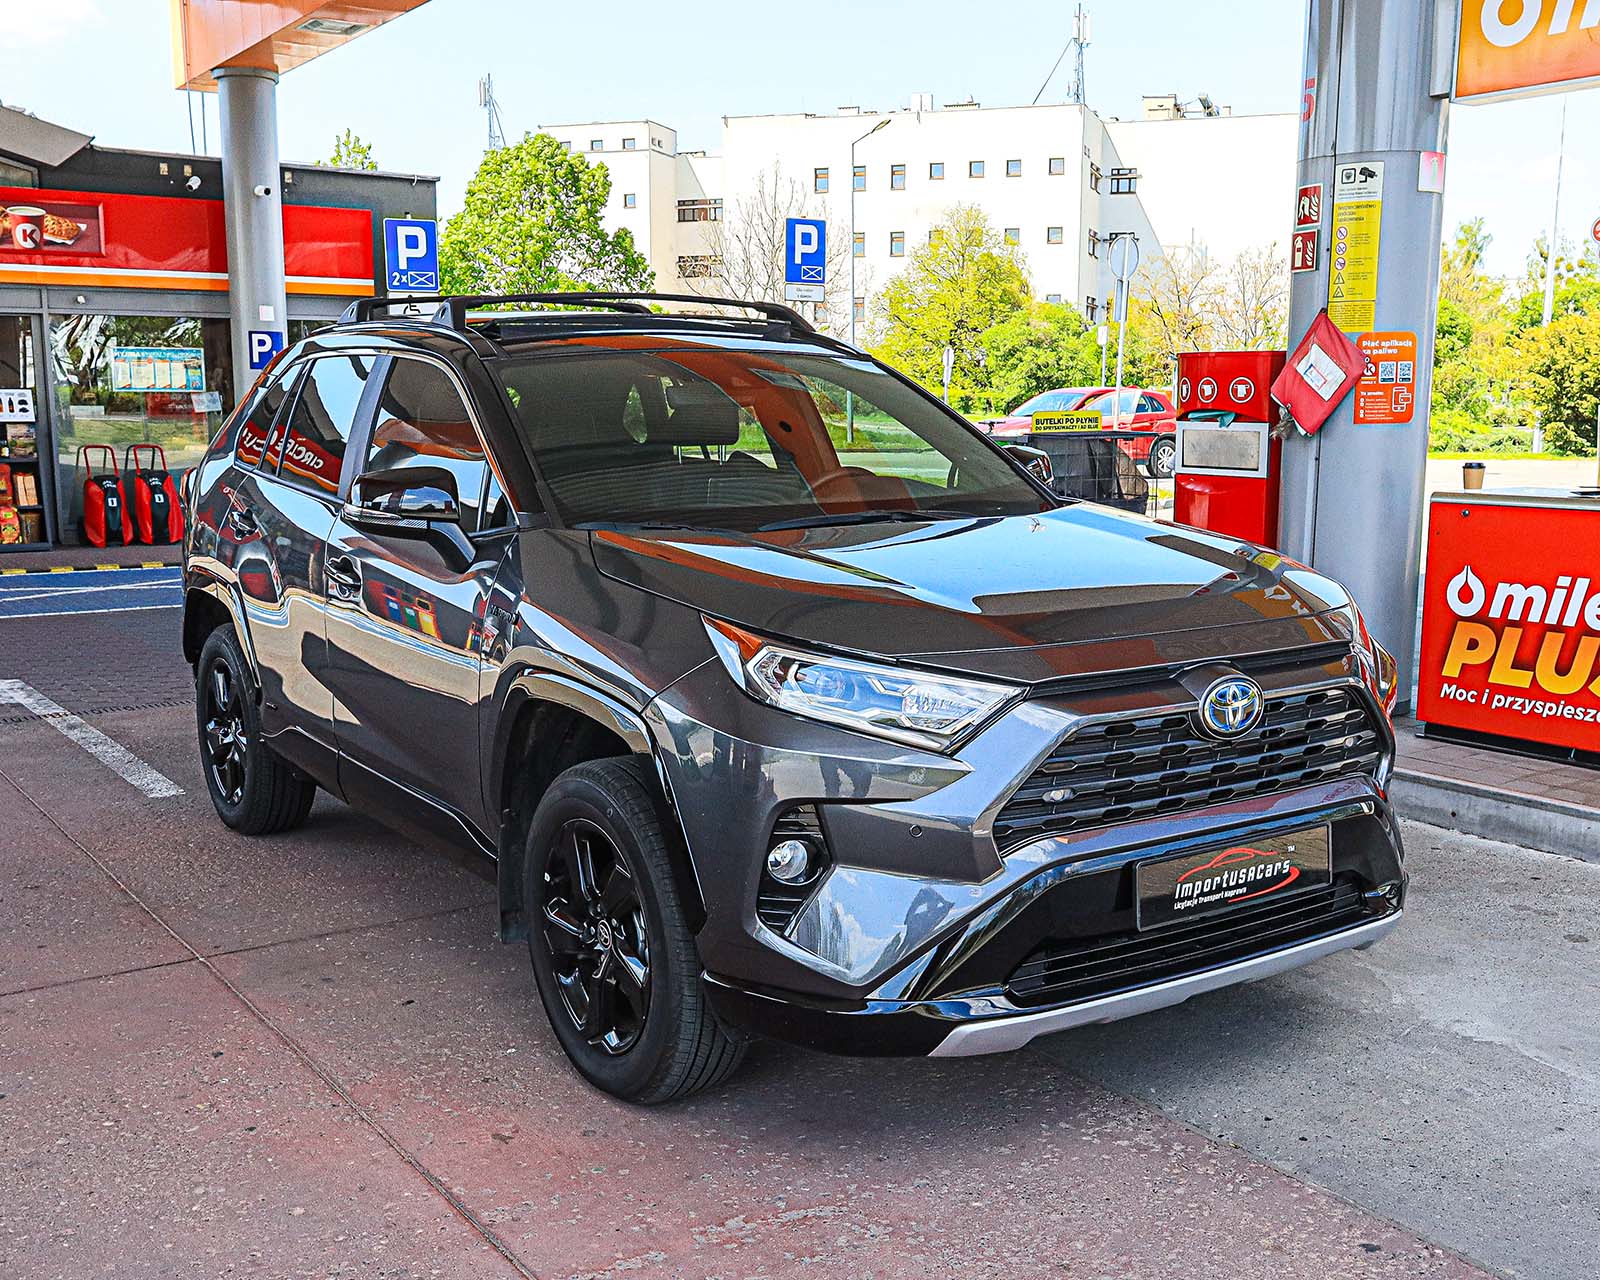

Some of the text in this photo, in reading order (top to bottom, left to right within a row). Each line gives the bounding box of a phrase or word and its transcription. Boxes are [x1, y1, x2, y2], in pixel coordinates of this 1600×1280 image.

[22, 228, 40, 248] K
[397, 226, 427, 270] P
[795, 223, 819, 265] P
[251, 333, 273, 363] P
[1372, 347, 1399, 356] paliwo
[1076, 416, 1099, 424] PŁYNIE
[1441, 620, 1600, 698] PLU
[1440, 683, 1478, 703] Moc
[1481, 688, 1490, 705] i
[1198, 891, 1224, 904] Transport
